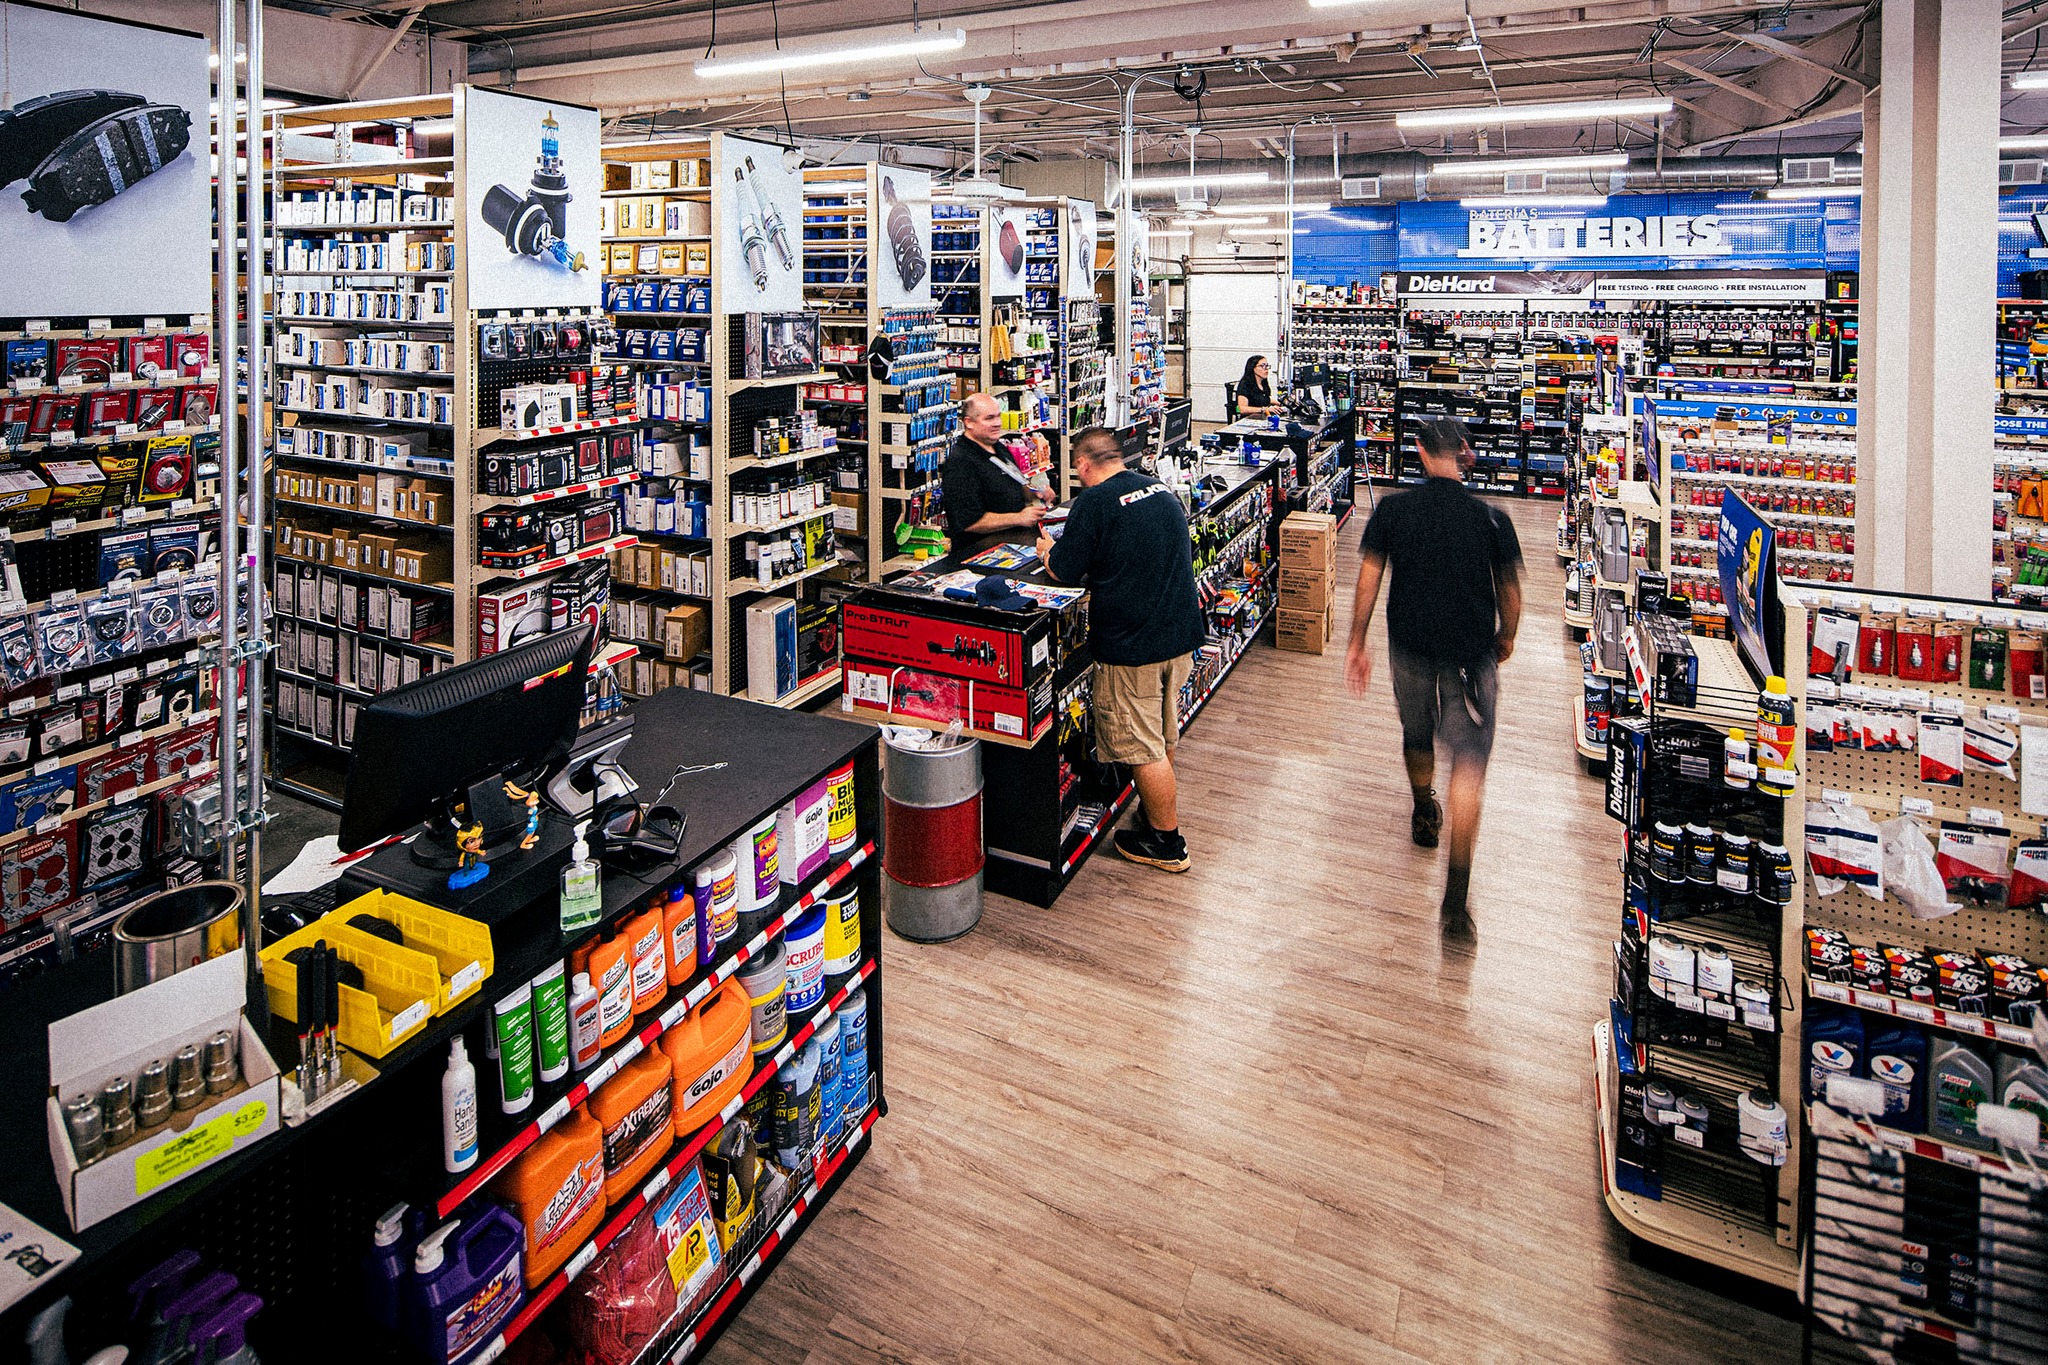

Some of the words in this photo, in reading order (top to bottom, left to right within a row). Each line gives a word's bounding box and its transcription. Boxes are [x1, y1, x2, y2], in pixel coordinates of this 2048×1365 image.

[1469, 207, 1538, 221] BATERÍAS
[1469, 215, 1721, 250] BATTERIES
[1408, 275, 1496, 293] DieHard
[1994, 420, 2023, 428] OOSE
[2026, 420, 2047, 429] THE
[0, 492, 29, 512] CCEL
[125, 533, 146, 541] BOSCH
[158, 588, 177, 596] BOSCH
[1641, 582, 1666, 590] DieHard
[59, 610, 79, 618] BOSCH
[570, 601, 581, 627] CLEA
[9, 621, 25, 631] BOSCH
[1586, 692, 1603, 702] Scott
[1609, 744, 1625, 817] DieHard
[1943, 831, 1974, 842] PRIME
[65, 895, 95, 912] VDO
[25, 936, 52, 951] BOSCH
[636, 970, 651, 980] Hand
[636, 972, 657, 987] Cleaner
[603, 1002, 618, 1013] Hand
[603, 1004, 624, 1020] Cleaner
[690, 1068, 724, 1098] GOJO
[1946, 1075, 1971, 1087] Castrol
[234, 1106, 266, 1127] $3.25
[545, 1160, 584, 1223] FAST
[678, 1189, 699, 1219] SHOP
[679, 1195, 708, 1232] OWELS
